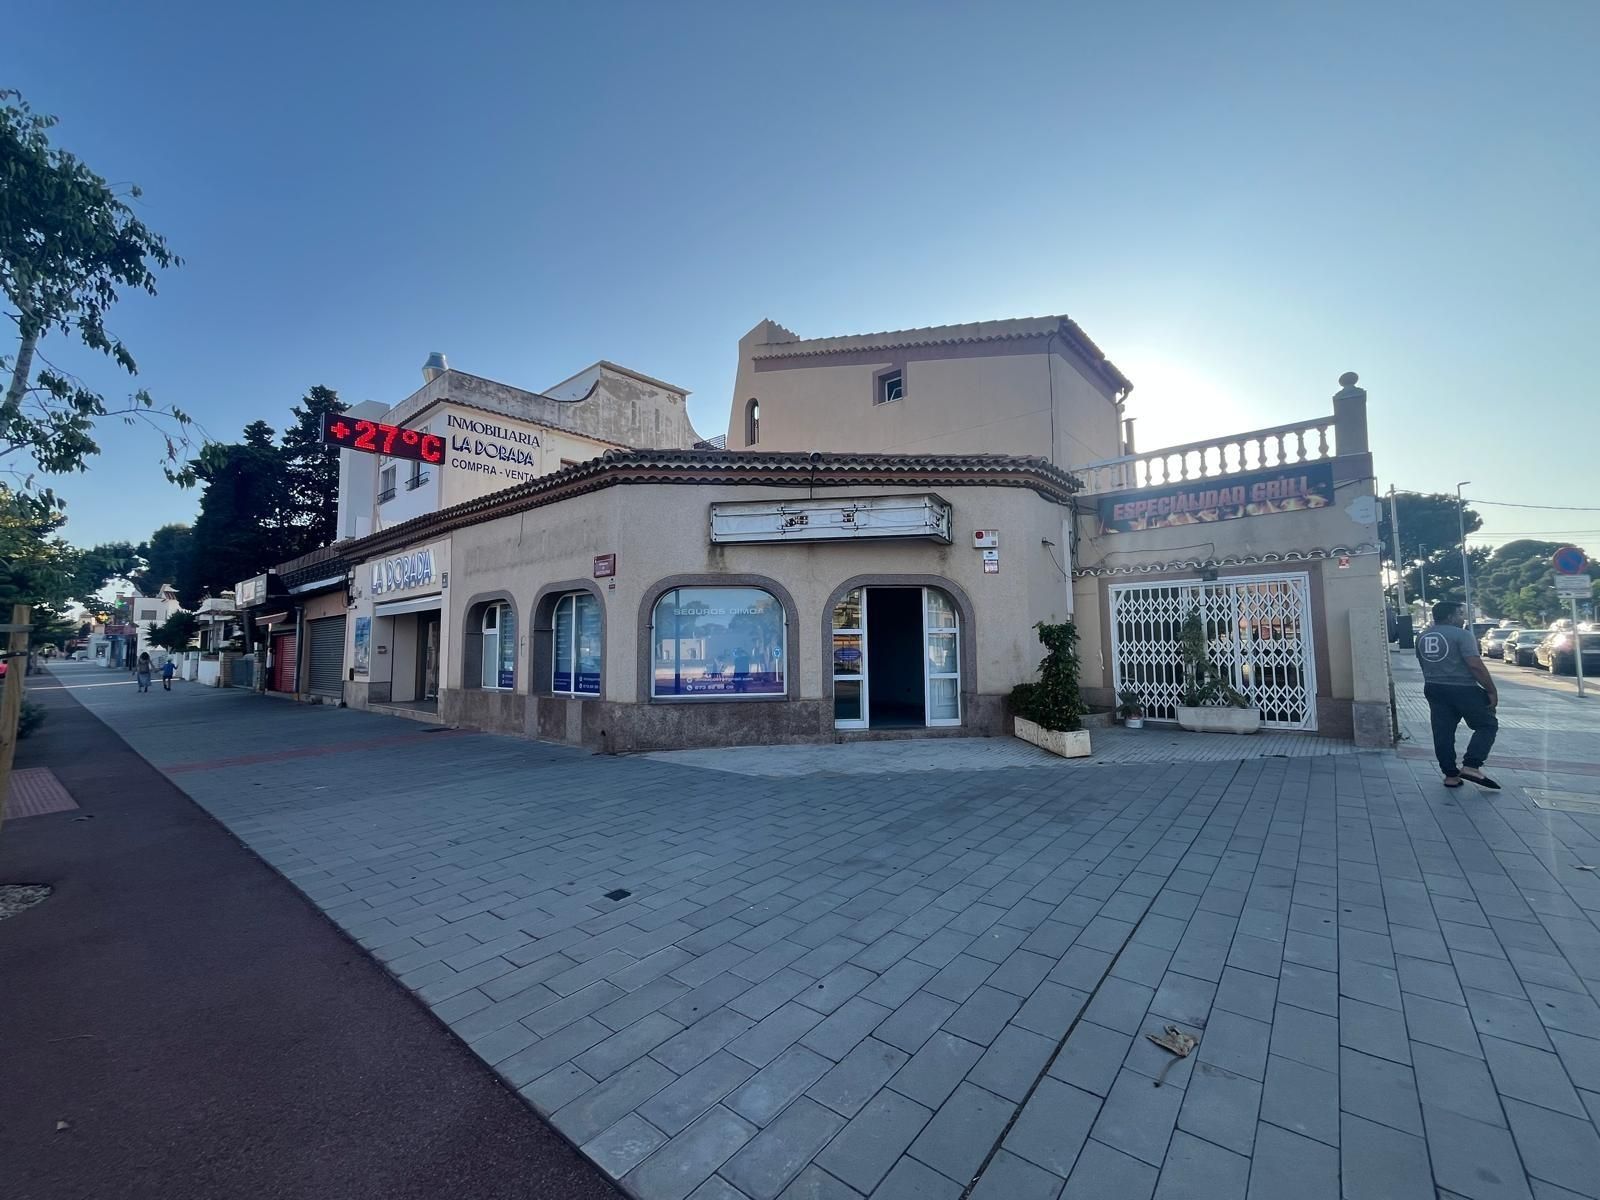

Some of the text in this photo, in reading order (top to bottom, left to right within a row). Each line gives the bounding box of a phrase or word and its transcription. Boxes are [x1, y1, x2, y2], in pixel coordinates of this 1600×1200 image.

[447, 415, 540, 448] INMOBILIARIA
[452, 434, 535, 467] LA DORADA
[451, 458, 497, 476] COMPRA
[505, 469, 535, 483] VENTA
[1113, 475, 1309, 521] ESPECIALIDAD GRILL
[371, 563, 384, 595] LA
[385, 549, 432, 592] DORADA
[673, 608, 726, 616] SEGUROS
